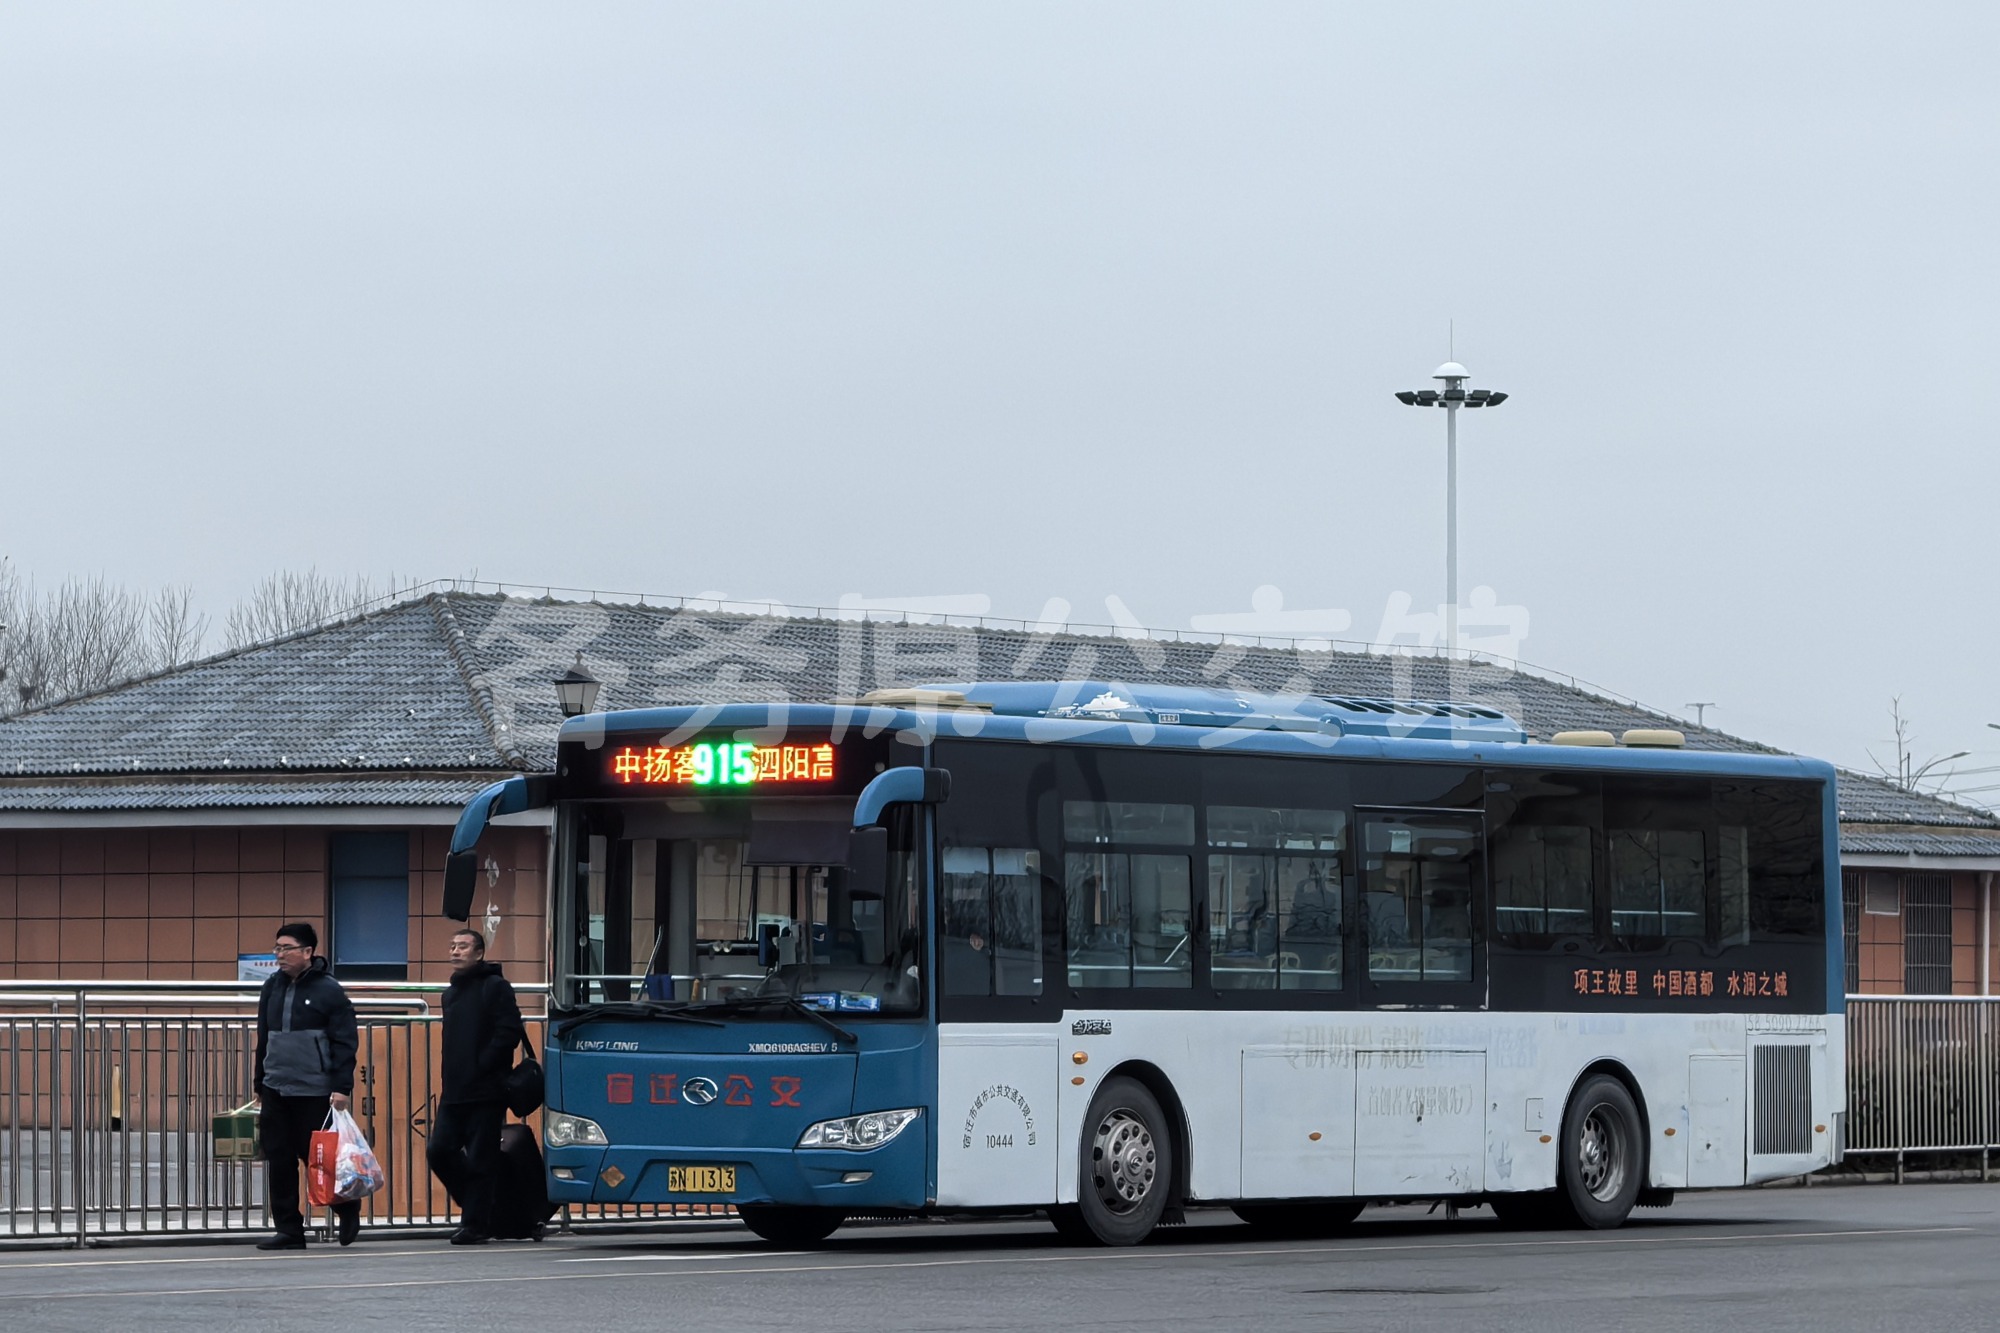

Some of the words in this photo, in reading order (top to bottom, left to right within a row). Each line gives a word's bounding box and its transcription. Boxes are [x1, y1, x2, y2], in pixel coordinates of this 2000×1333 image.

[693, 743, 755, 784] 915
[1574, 968, 1638, 995] 项王故里
[1653, 969, 1714, 996] 中国酒都
[986, 1134, 1013, 1149] 10444
